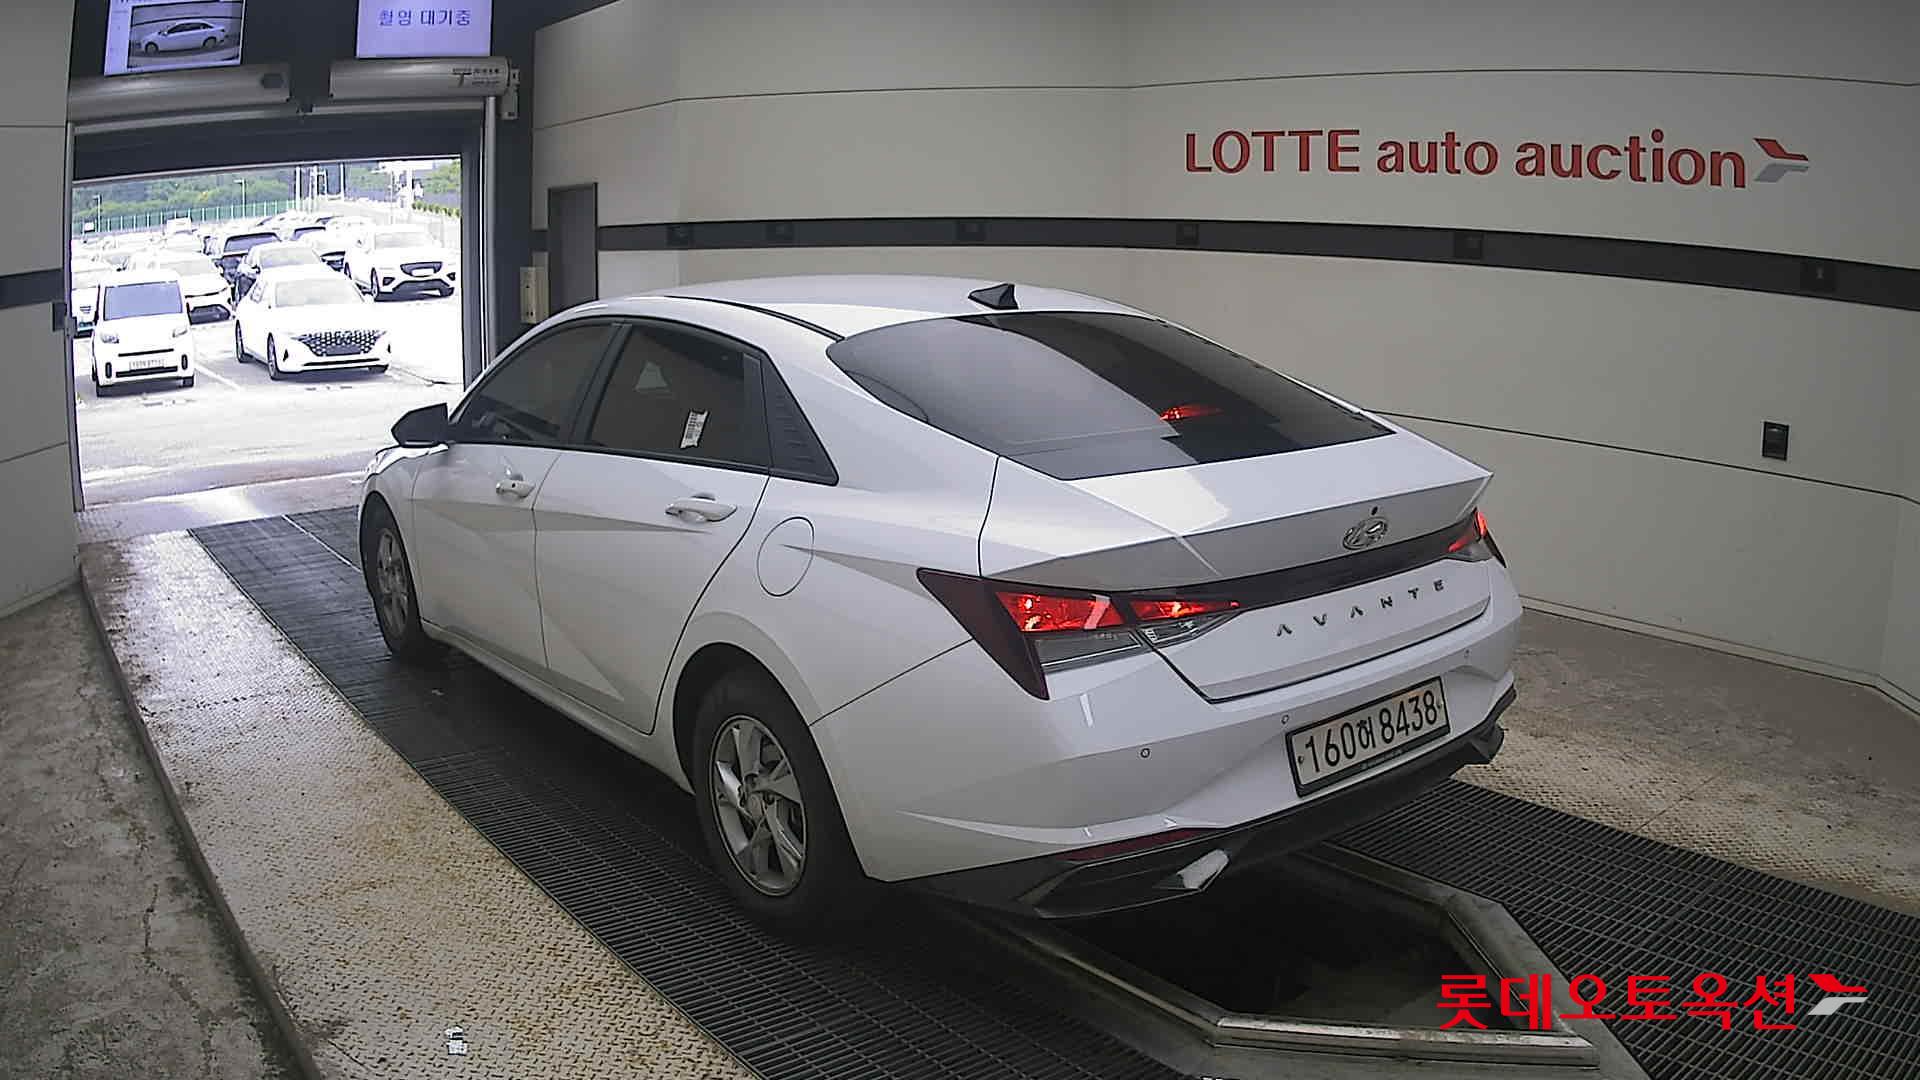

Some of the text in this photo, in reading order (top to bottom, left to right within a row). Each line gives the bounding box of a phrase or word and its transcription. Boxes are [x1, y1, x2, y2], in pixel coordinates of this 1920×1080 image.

[420, 9, 471, 26] 대기중
[1186, 129, 1745, 188] LOTTE auto auction
[1276, 580, 1446, 637] AVANTE
